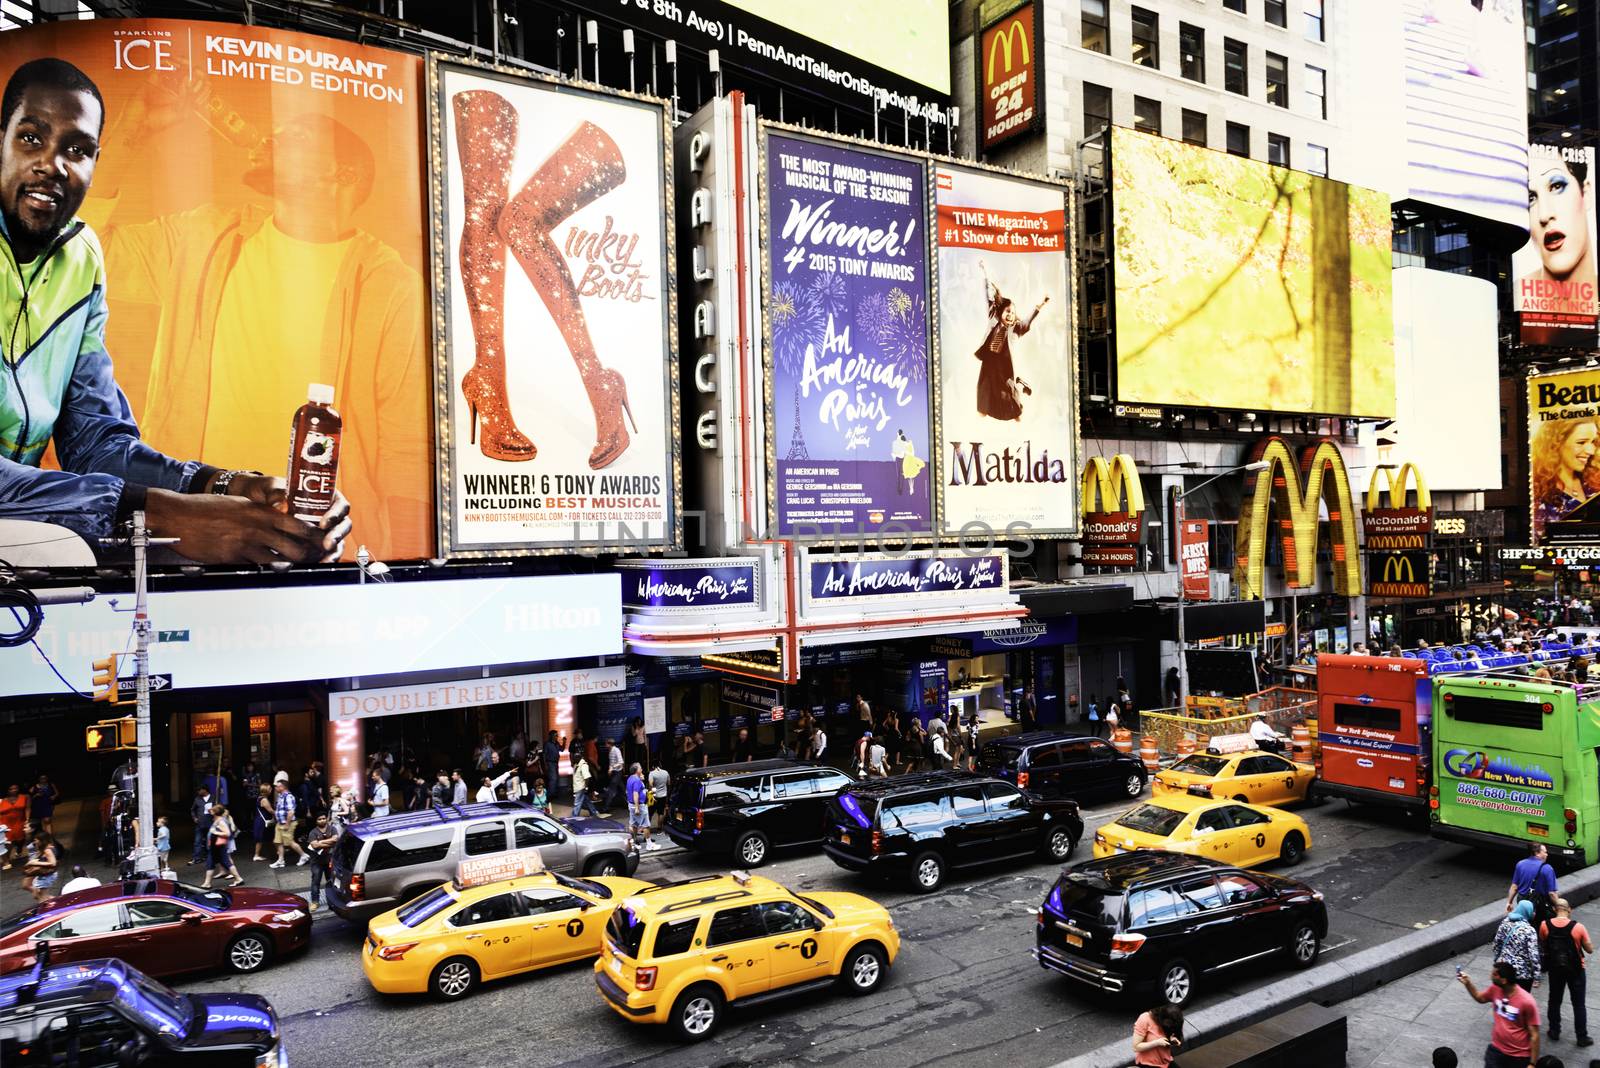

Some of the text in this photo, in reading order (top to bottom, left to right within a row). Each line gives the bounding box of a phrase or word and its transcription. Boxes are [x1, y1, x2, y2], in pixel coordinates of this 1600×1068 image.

[653, 0, 682, 23] 8th
[686, 10, 724, 41] Ave)
[114, 39, 175, 71] ICE
[205, 35, 388, 80] KEVIN DURANT
[206, 57, 403, 105] LIMITED EDITION
[991, 70, 1028, 100] OPEN
[995, 87, 1023, 120] 24
[987, 107, 1033, 139] HOURS
[1562, 147, 1592, 163] CRISS
[779, 154, 913, 191] THE MOST AWARD-WINNING
[785, 170, 910, 206] MUSICAL OF THE SEASON!
[782, 198, 916, 257] Winner!
[953, 211, 1049, 231] TIME Magazine's
[945, 229, 1059, 247] #1 Show of the Year!
[783, 246, 915, 282] 4 2015 TONY AWARDS
[576, 264, 656, 303] Boots
[690, 130, 717, 449] PALACE
[1521, 278, 1594, 301] HEDWIG
[1522, 298, 1594, 313] ANGRY INCH
[821, 313, 852, 359] An
[800, 343, 912, 407] American
[819, 388, 891, 432] Paris
[1539, 406, 1595, 421] The Carole
[949, 440, 1067, 487] Matilda
[297, 474, 331, 494] ICE
[464, 475, 661, 495] WINNER! 6 TONY AWARDS
[465, 497, 661, 509] INCLUDING BEST MUSICAL
[464, 512, 563, 522] KINKYBOOTSTHEMUSICAL.COM
[568, 512, 581, 521] FOR
[582, 512, 607, 521] TICKETS
[608, 512, 622, 521] CALL
[1366, 515, 1428, 526] McDonald's
[1083, 522, 1137, 533] McDonald's
[1088, 533, 1127, 541] Restaurant
[1110, 553, 1134, 561] HOURS
[1182, 541, 1209, 560] JERSEY
[1498, 548, 1544, 559] GIFTS
[977, 558, 992, 571] New
[822, 566, 845, 594] An
[849, 562, 922, 595] American
[926, 560, 964, 590] Paris
[970, 571, 995, 588] Musical
[645, 575, 694, 602] American
[697, 575, 729, 600] Paris
[504, 603, 600, 633] Hilton
[164, 631, 172, 641] 7
[1009, 625, 1047, 635] EXCHANGE
[930, 645, 971, 657] EXCHANGE
[935, 636, 961, 646] MONEY
[573, 673, 590, 683] BY
[573, 679, 618, 691] HILTON
[1524, 694, 1541, 703] 304
[1372, 742, 1393, 750] Expert!
[1484, 771, 1553, 788] New York Tours
[1457, 783, 1545, 805] 888-680-GONY
[1456, 796, 1546, 817] www.gonytours.com
[463, 853, 523, 873] FLASHDANCERS
[463, 863, 523, 879] GENTLEMEN'S CLUB
